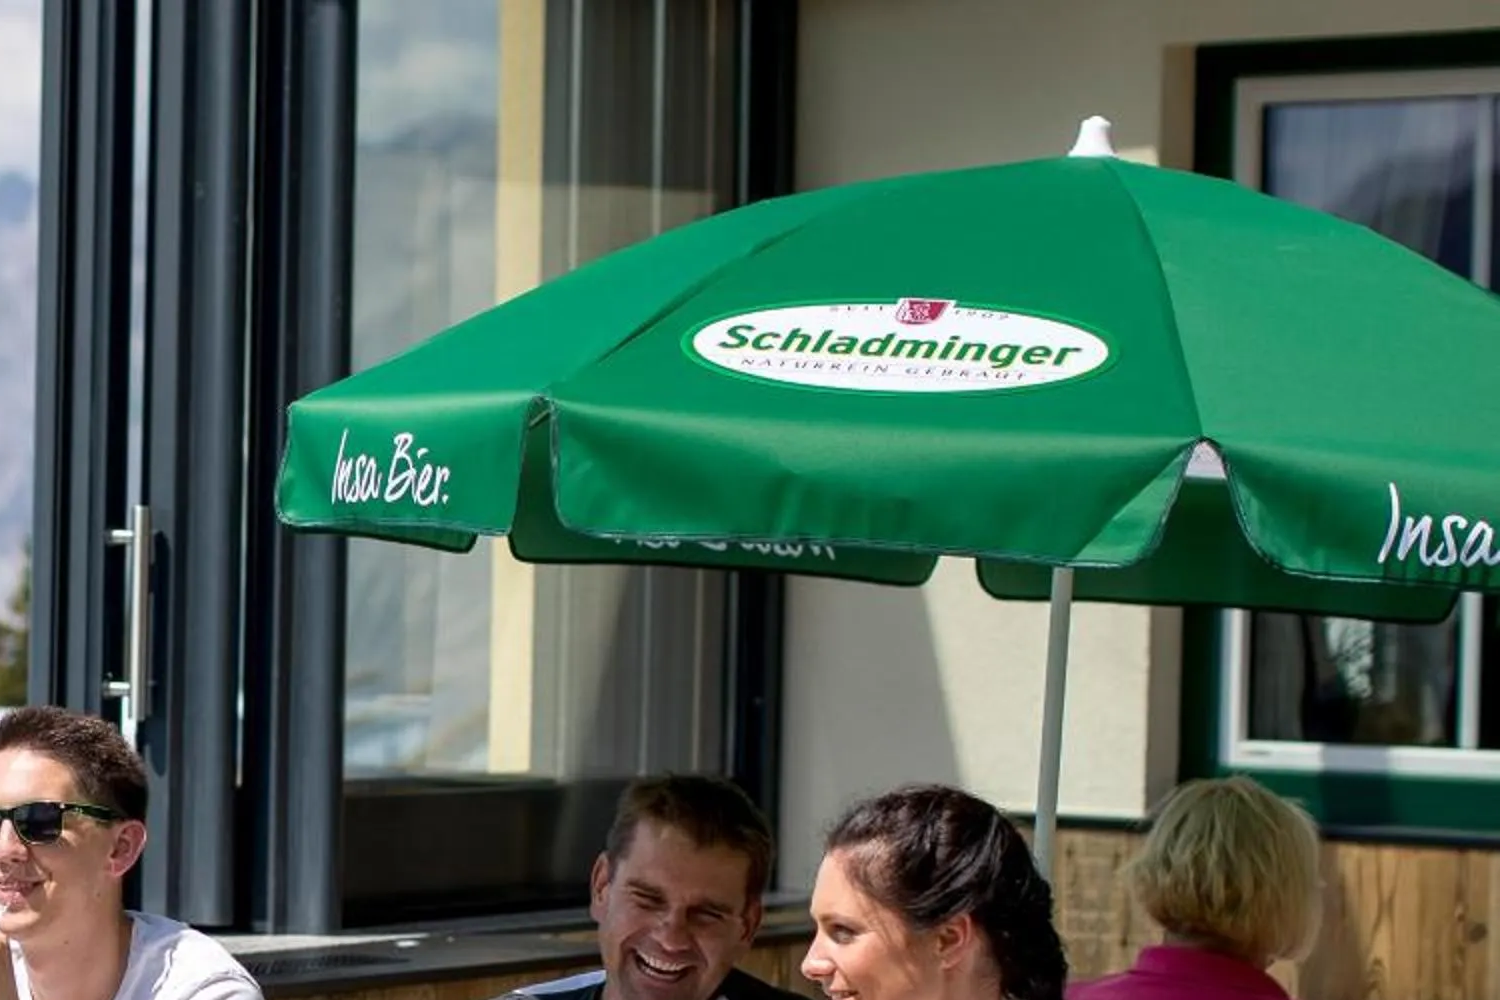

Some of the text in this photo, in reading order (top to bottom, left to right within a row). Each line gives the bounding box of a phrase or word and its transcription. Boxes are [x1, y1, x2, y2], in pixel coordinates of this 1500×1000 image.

[718, 324, 1083, 369] Schladminger
[331, 427, 382, 504] Insa
[1377, 480, 1500, 568] Insa
